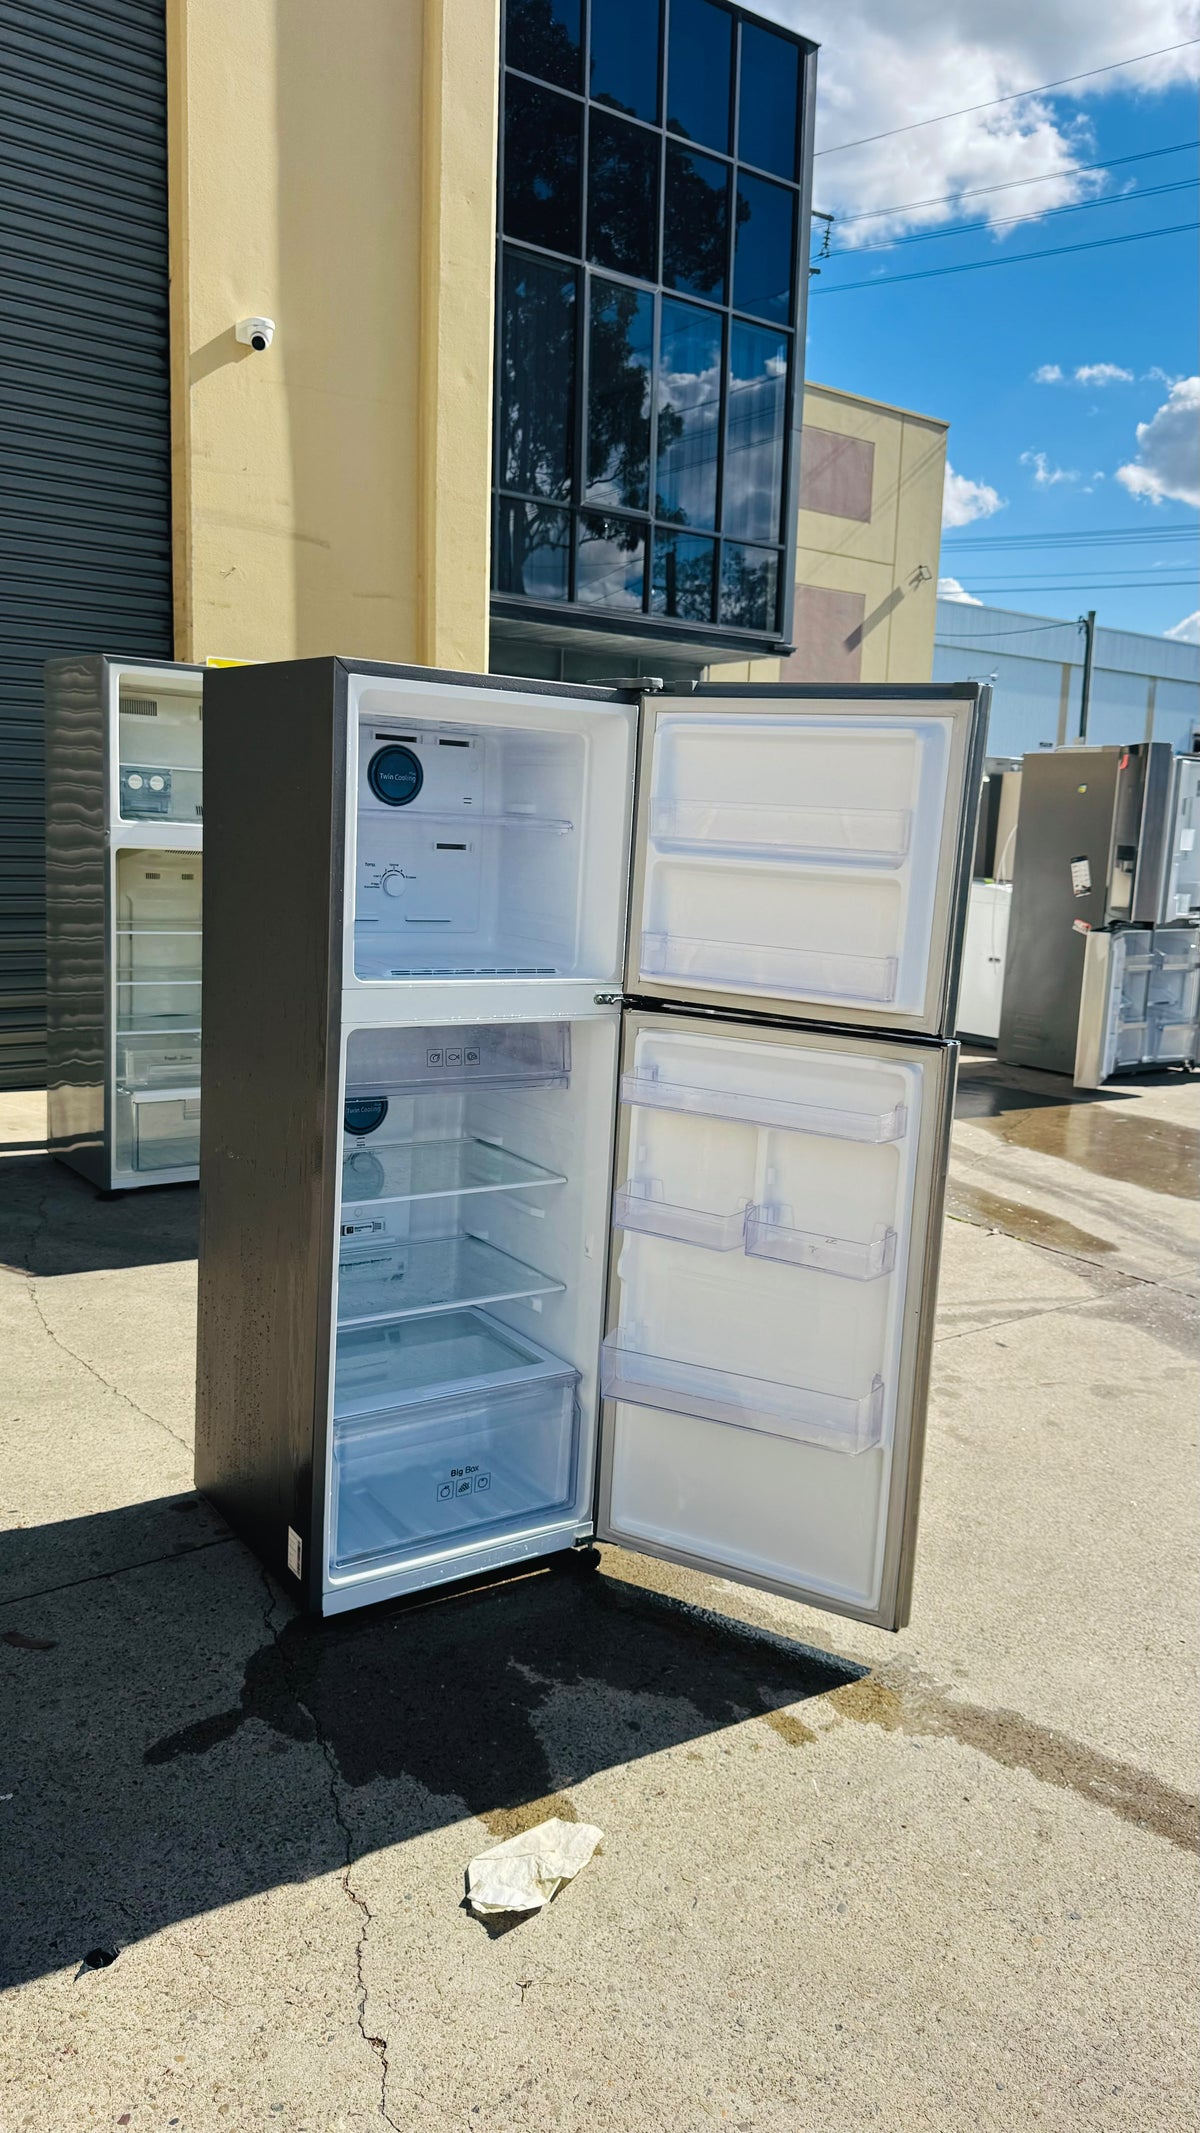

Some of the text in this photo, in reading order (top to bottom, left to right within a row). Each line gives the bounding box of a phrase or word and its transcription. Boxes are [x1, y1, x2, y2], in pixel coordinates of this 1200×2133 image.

[380, 772, 394, 780] Twin
[395, 773, 416, 784] Cooling
[451, 1465, 479, 1477] Big Box
